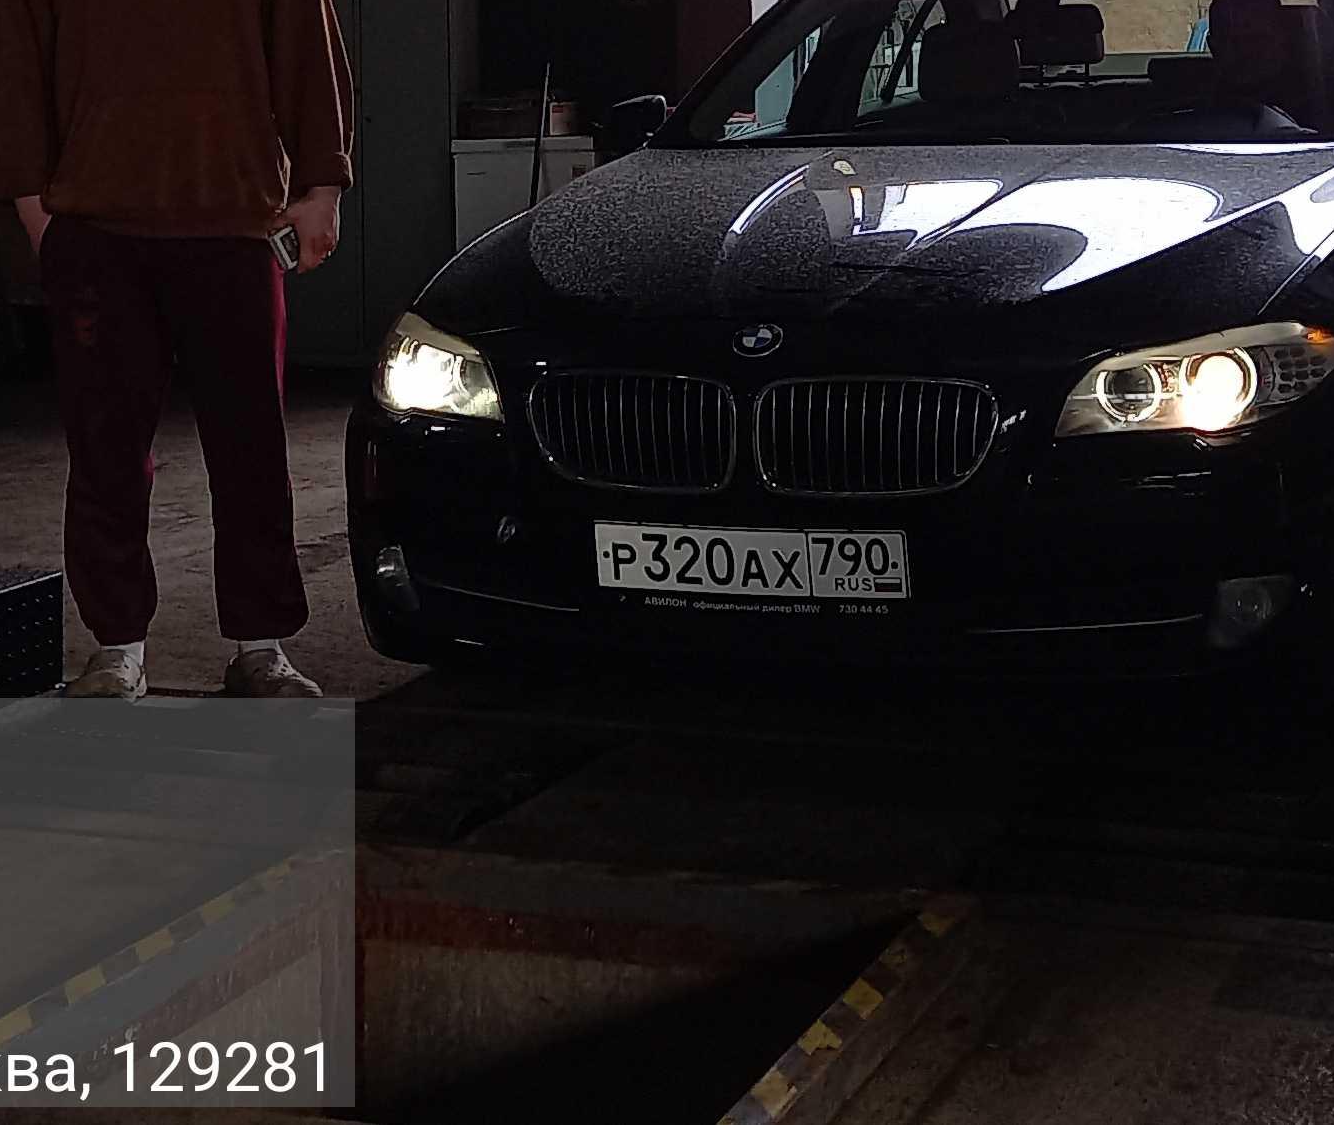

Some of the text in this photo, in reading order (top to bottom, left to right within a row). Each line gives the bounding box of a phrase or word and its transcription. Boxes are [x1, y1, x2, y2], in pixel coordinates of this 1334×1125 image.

[612, 532, 890, 590] Р320АХ 790
[834, 577, 873, 592] RUS
[644, 596, 687, 608] АВИЛОН
[794, 604, 821, 613] BMW
